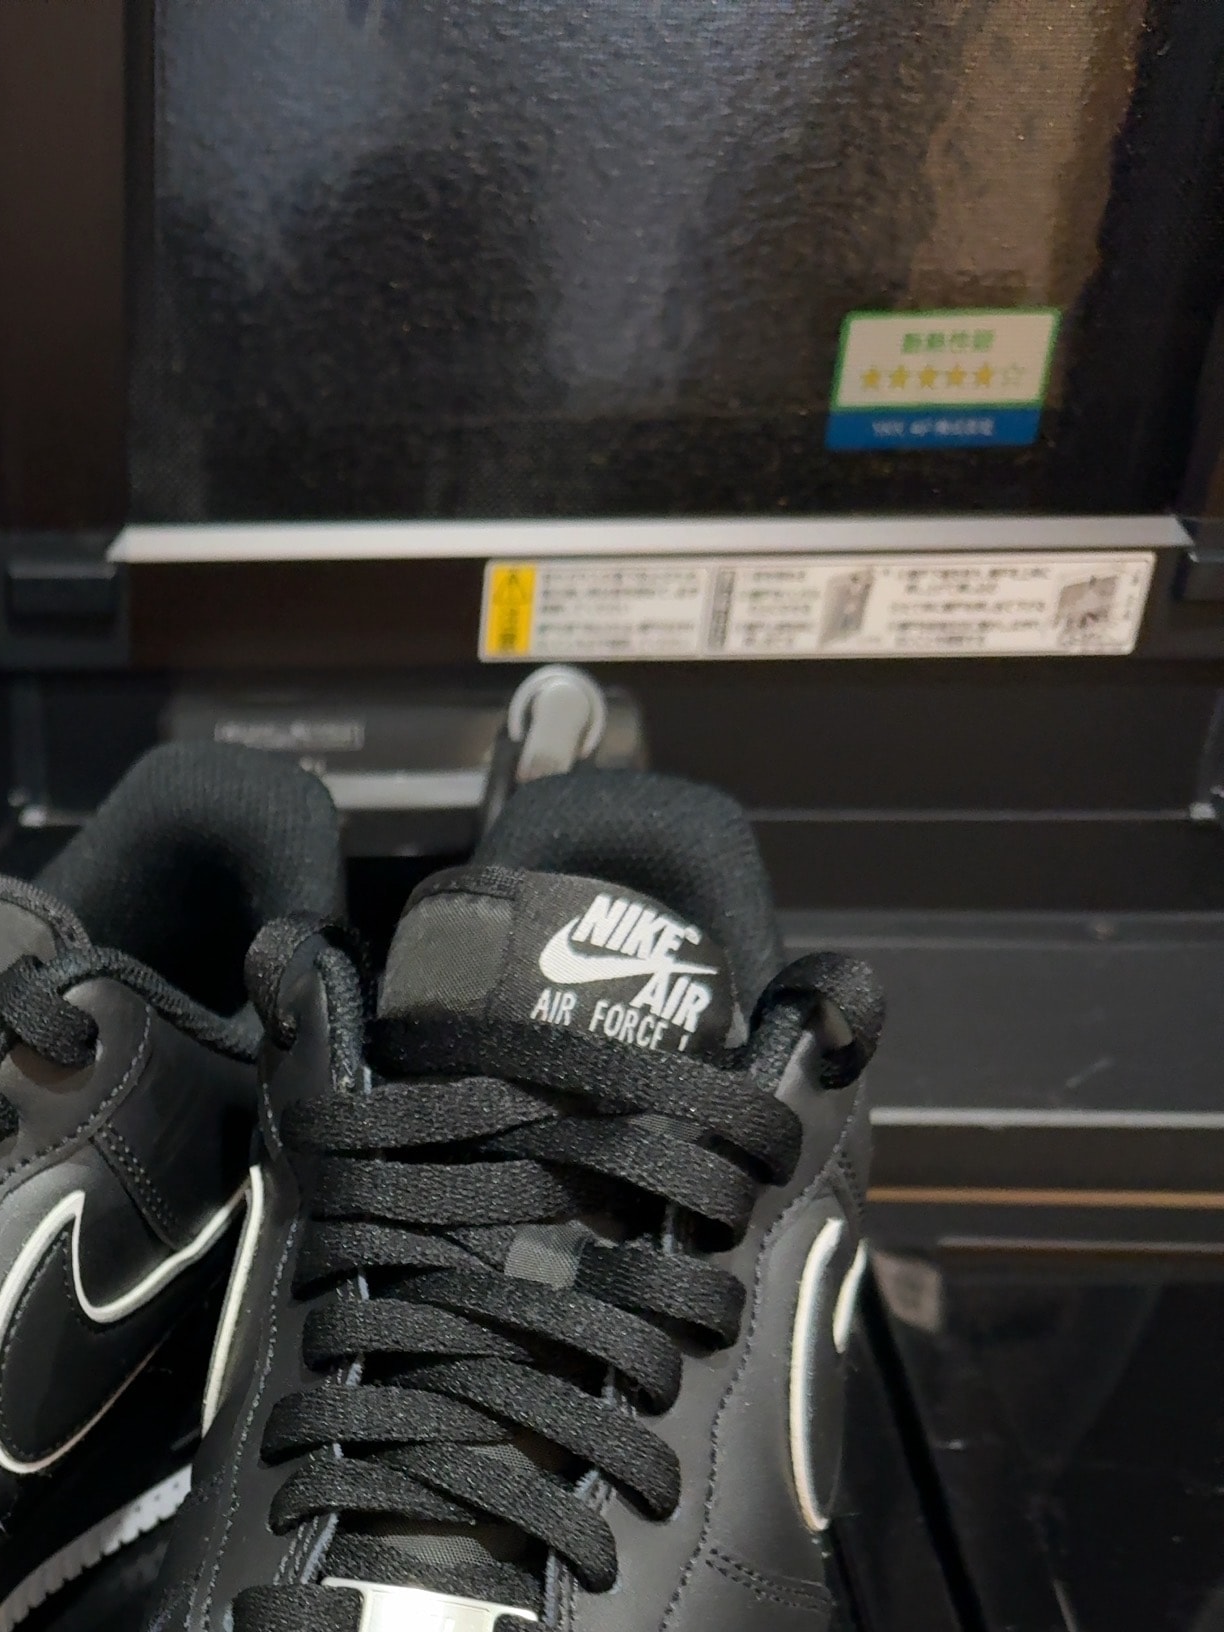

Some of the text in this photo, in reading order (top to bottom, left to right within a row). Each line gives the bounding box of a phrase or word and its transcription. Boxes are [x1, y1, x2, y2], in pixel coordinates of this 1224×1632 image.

[571, 894, 687, 962] NIKE
[530, 988, 577, 1027] AIR
[588, 999, 669, 1051] FORCE
[629, 967, 713, 1034] AIR
